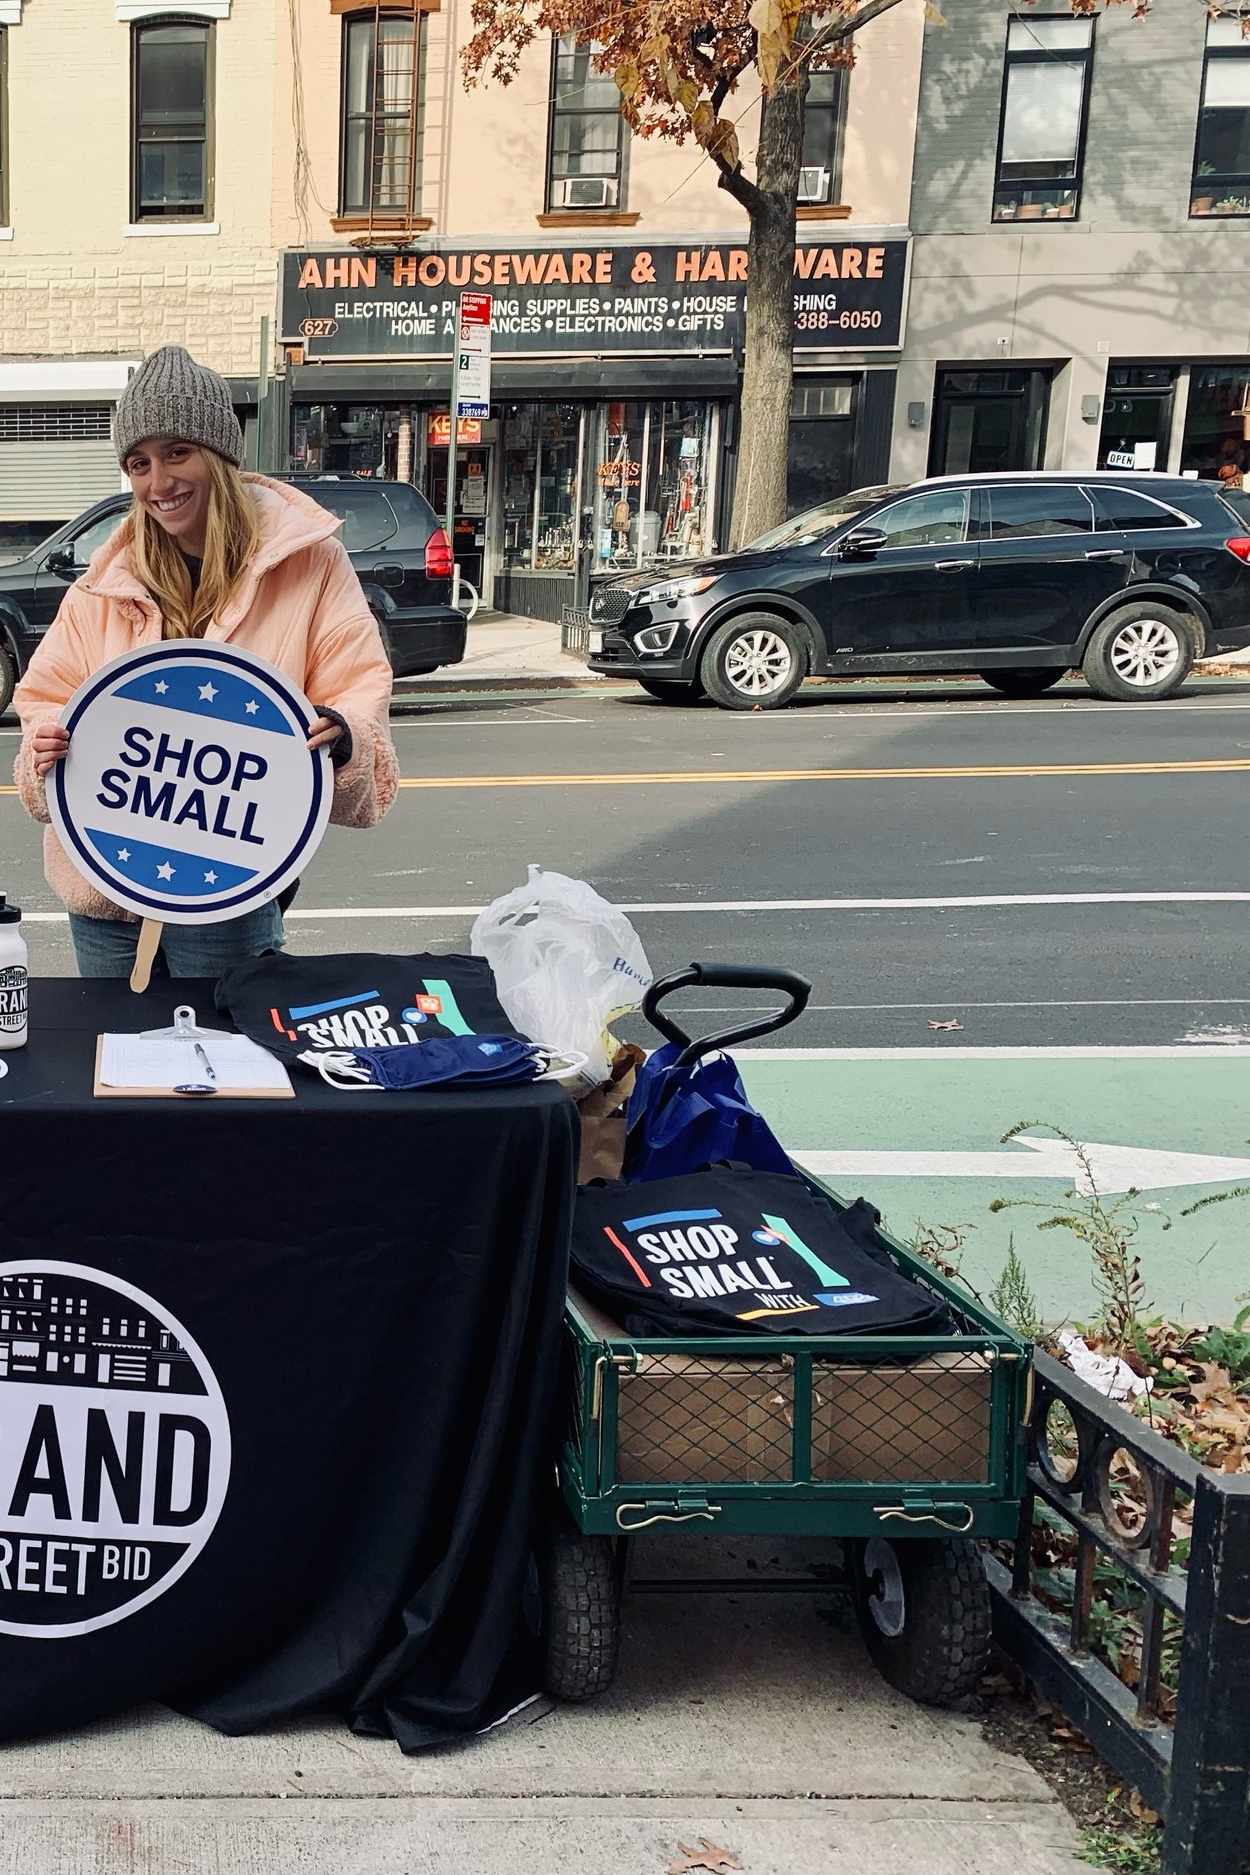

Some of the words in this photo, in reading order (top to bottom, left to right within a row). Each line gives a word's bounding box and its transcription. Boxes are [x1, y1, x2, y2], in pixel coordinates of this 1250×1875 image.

[298, 256, 377, 289] AHN
[393, 252, 614, 288] HOUSEWARE
[631, 251, 658, 284] &
[675, 246, 887, 283] HARWARE
[334, 301, 429, 319] ELECTRICAL
[526, 297, 601, 317] SUPPLIES
[614, 296, 669, 315] PAINTS
[683, 295, 738, 313] HOUSE
[303, 320, 333, 336] 627
[391, 319, 436, 336] HOME
[555, 315, 664, 334] ELECTRONICS
[678, 313, 725, 332] GIFTS
[461, 355, 468, 369] 2
[428, 415, 481, 434] KEYS
[597, 461, 642, 477] KEYS
[1109, 453, 1134, 465] OPEN
[118, 726, 269, 792] SHOP
[95, 768, 266, 847] SMALL
[636, 1223, 740, 1265] SHOP
[659, 1255, 794, 1299] SMALL
[754, 1292, 812, 1309] WITH
[101, 1544, 151, 1581] BID
